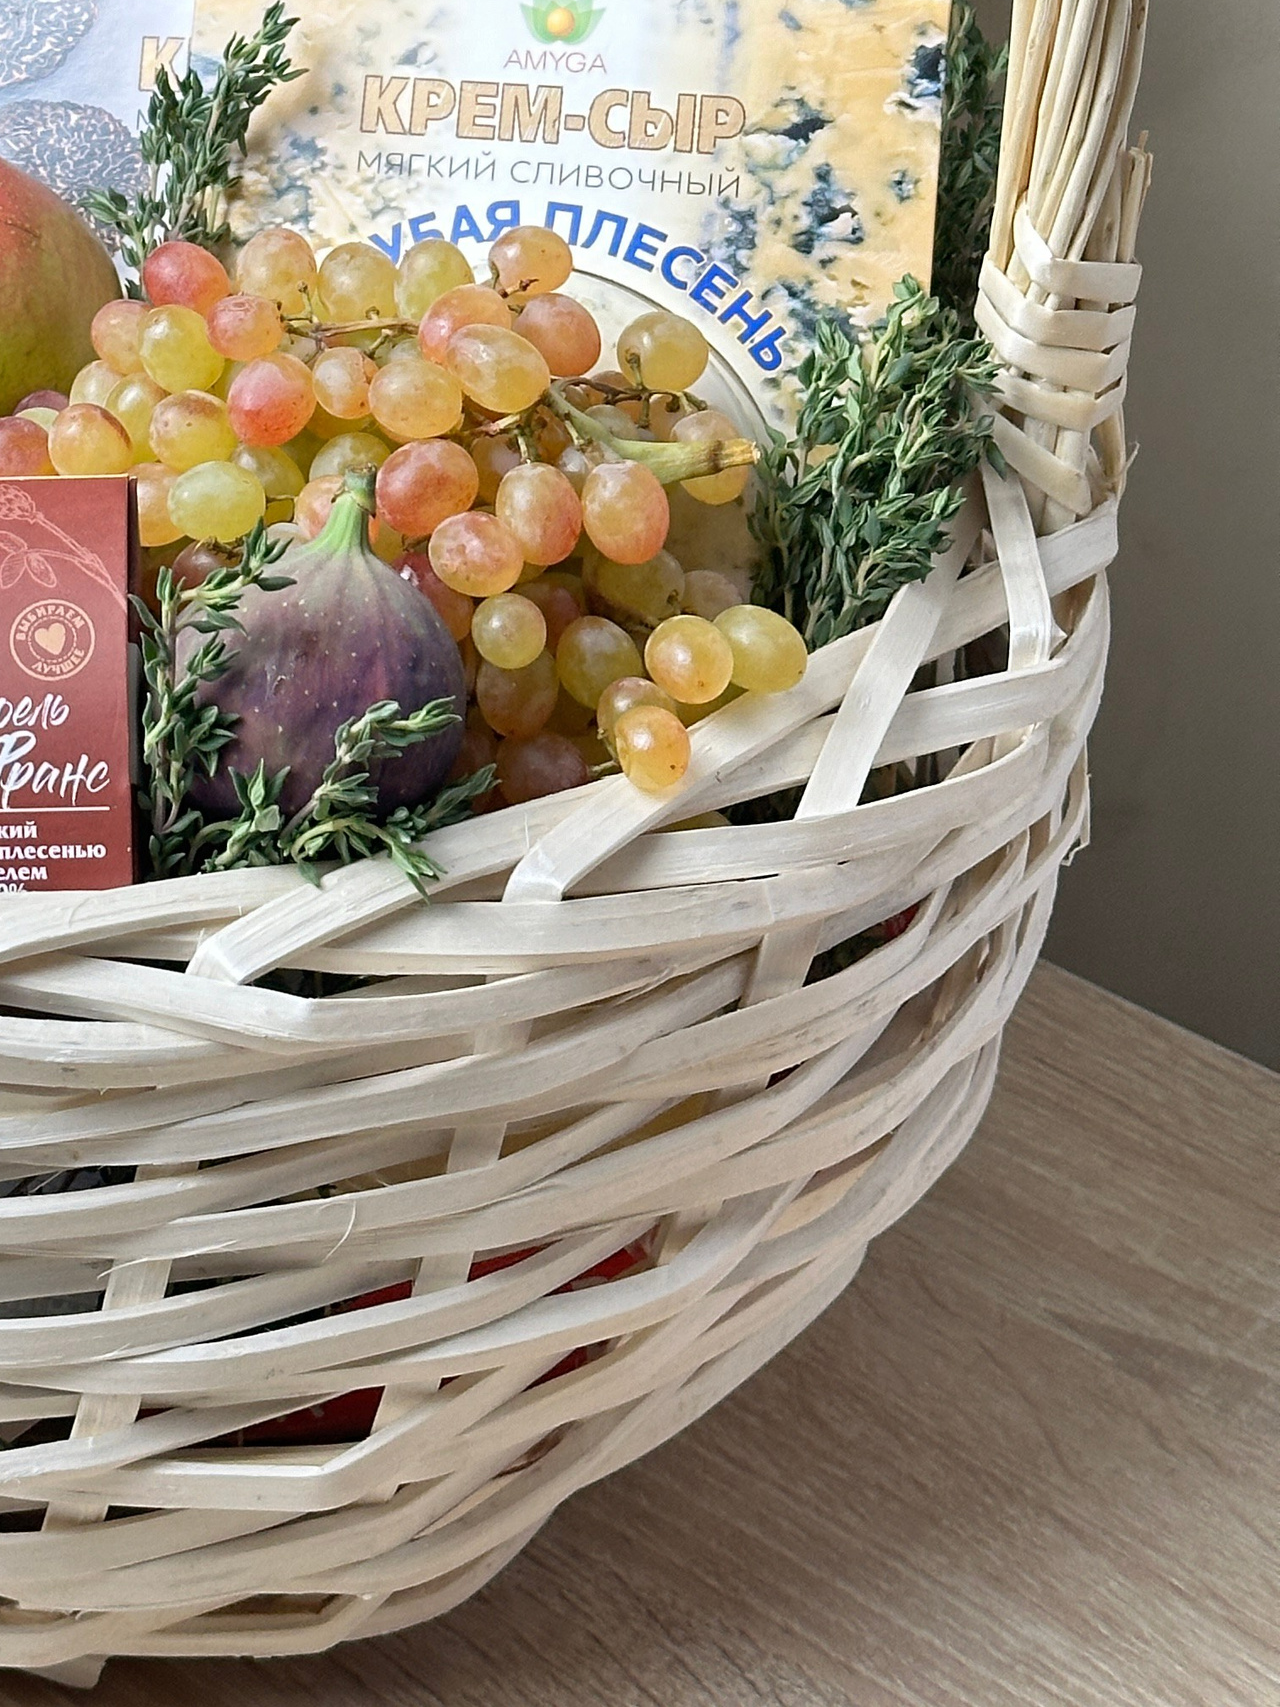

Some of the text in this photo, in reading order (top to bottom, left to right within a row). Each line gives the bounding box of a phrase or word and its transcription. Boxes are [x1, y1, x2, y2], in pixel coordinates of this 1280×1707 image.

[503, 49, 607, 74] AMYGA
[359, 74, 747, 154] КРЕМ-СЫР
[357, 149, 741, 198] МЯГКИЙ СЛИВОЧНЫЙ
[545, 201, 788, 372] ПЛЕСЕНЬ
[15, 604, 86, 642] ВЫБИРАЕМ
[31, 648, 85, 675] ЛУЧШЕЕ
